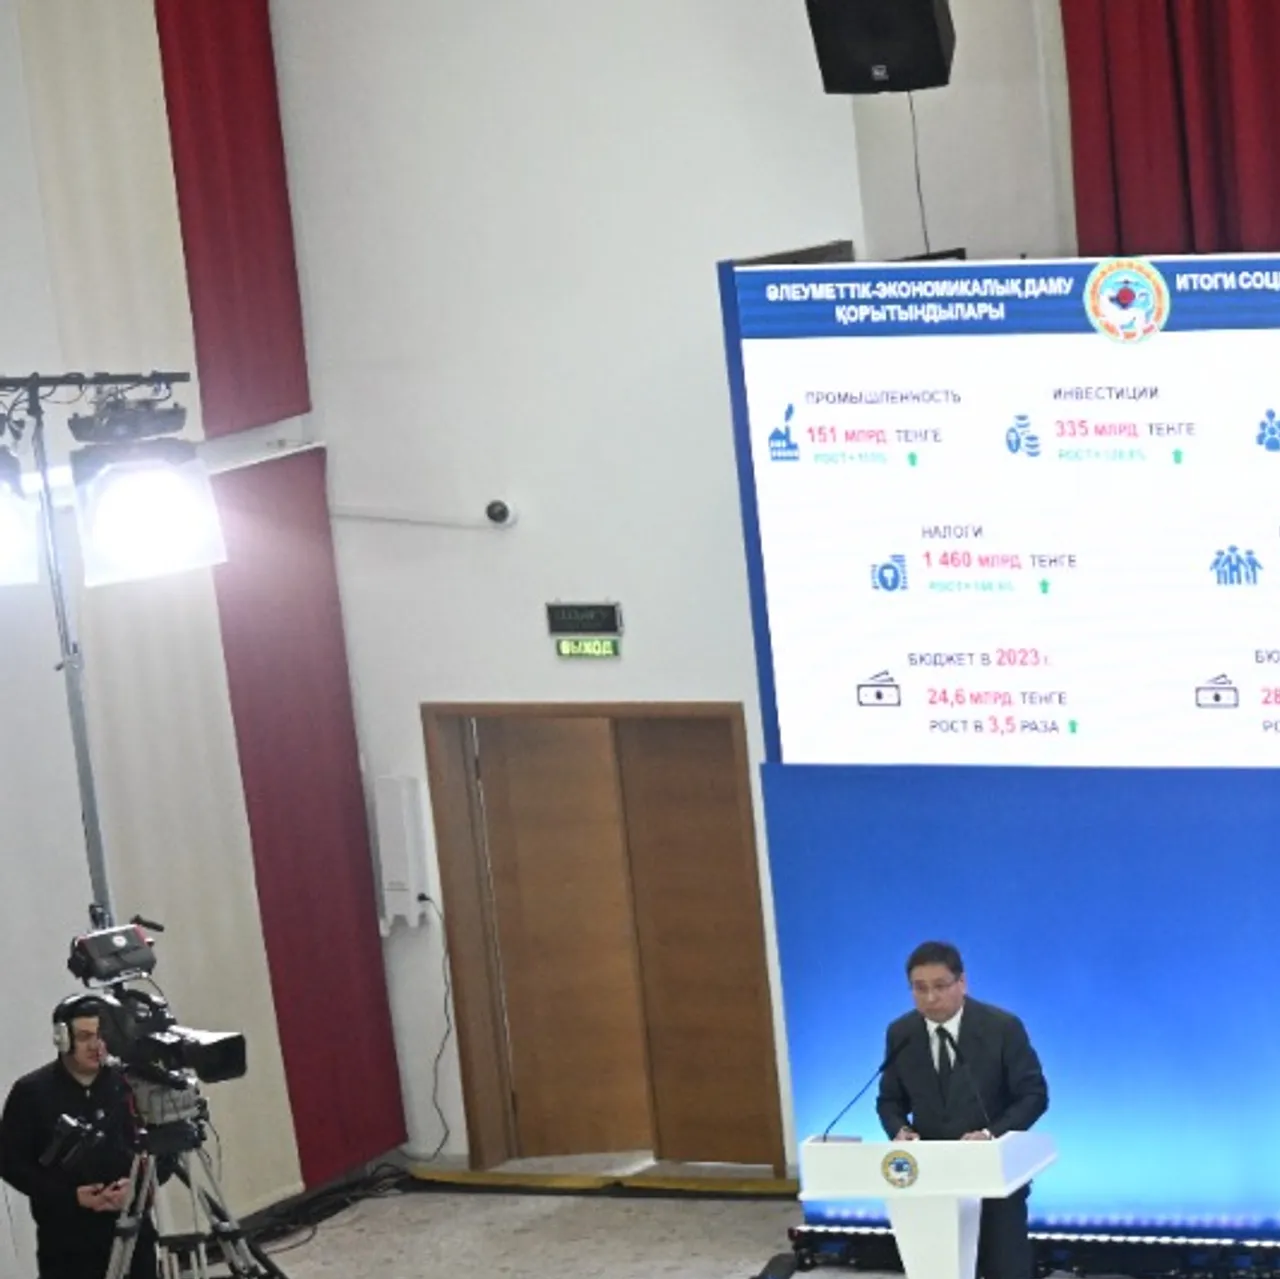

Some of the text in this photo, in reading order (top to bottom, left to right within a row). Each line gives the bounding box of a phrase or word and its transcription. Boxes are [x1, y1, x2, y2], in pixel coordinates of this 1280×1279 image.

[1025, 277, 1073, 298] ДАМУ
[1175, 271, 1236, 292] ИТОГИ
[805, 388, 961, 405] ПРОМЫШЛЕННОСТЬ
[1053, 385, 1158, 402] ИНВЕСТИЦИИ
[807, 425, 836, 443] 151
[895, 428, 943, 443] ТЕНГЕ
[1055, 419, 1088, 438] 335
[1147, 422, 1196, 437] ТЕНГЕ
[922, 523, 983, 539] НАЛОГИ
[938, 550, 972, 569] 460
[1029, 553, 1077, 569] ТЕНГЕ
[561, 639, 613, 656] ВЫХОД
[907, 652, 975, 668] БЮДЖЕТ
[980, 652, 991, 667] В
[995, 647, 1040, 667] 2023
[928, 688, 966, 708] 24,6
[1019, 690, 1067, 706] ТЕНГЕ
[929, 714, 1059, 736] РОСТ В 3,5 РАЗА
